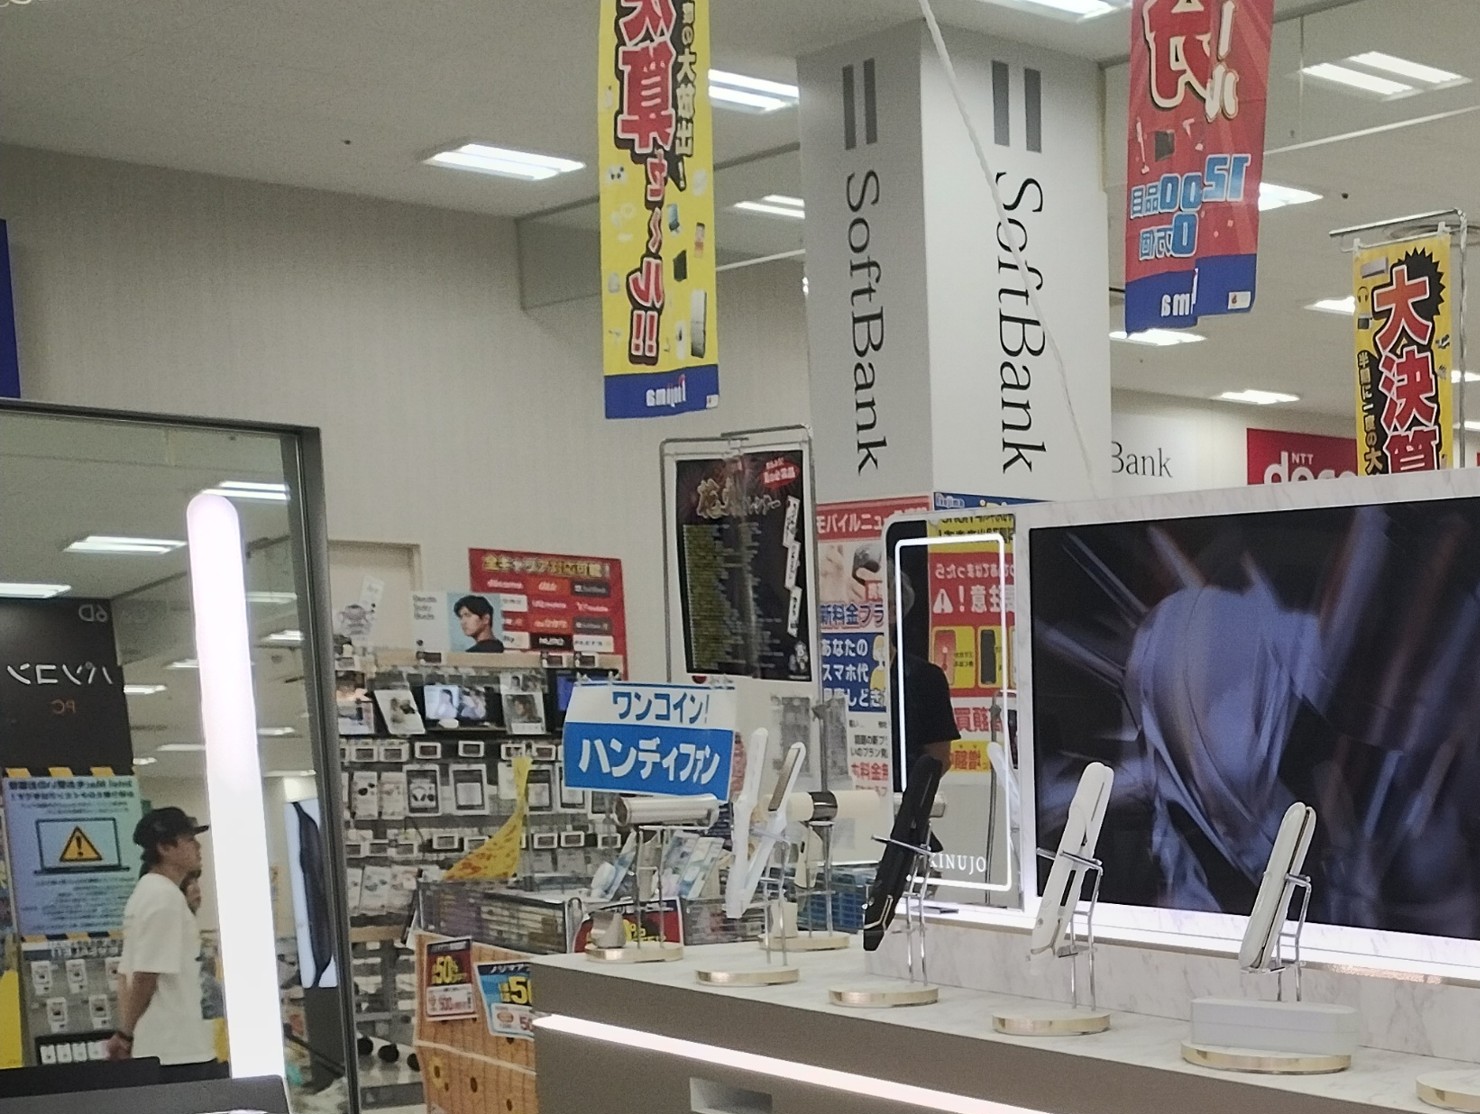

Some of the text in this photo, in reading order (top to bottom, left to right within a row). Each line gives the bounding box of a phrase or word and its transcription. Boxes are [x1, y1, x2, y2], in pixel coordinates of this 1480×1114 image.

[845, 169, 890, 478] SoftBank
[993, 167, 1050, 476] SoftBank
[1291, 453, 1315, 465] NTT
[821, 637, 869, 657] あなたの
[822, 662, 869, 683] スマホ代
